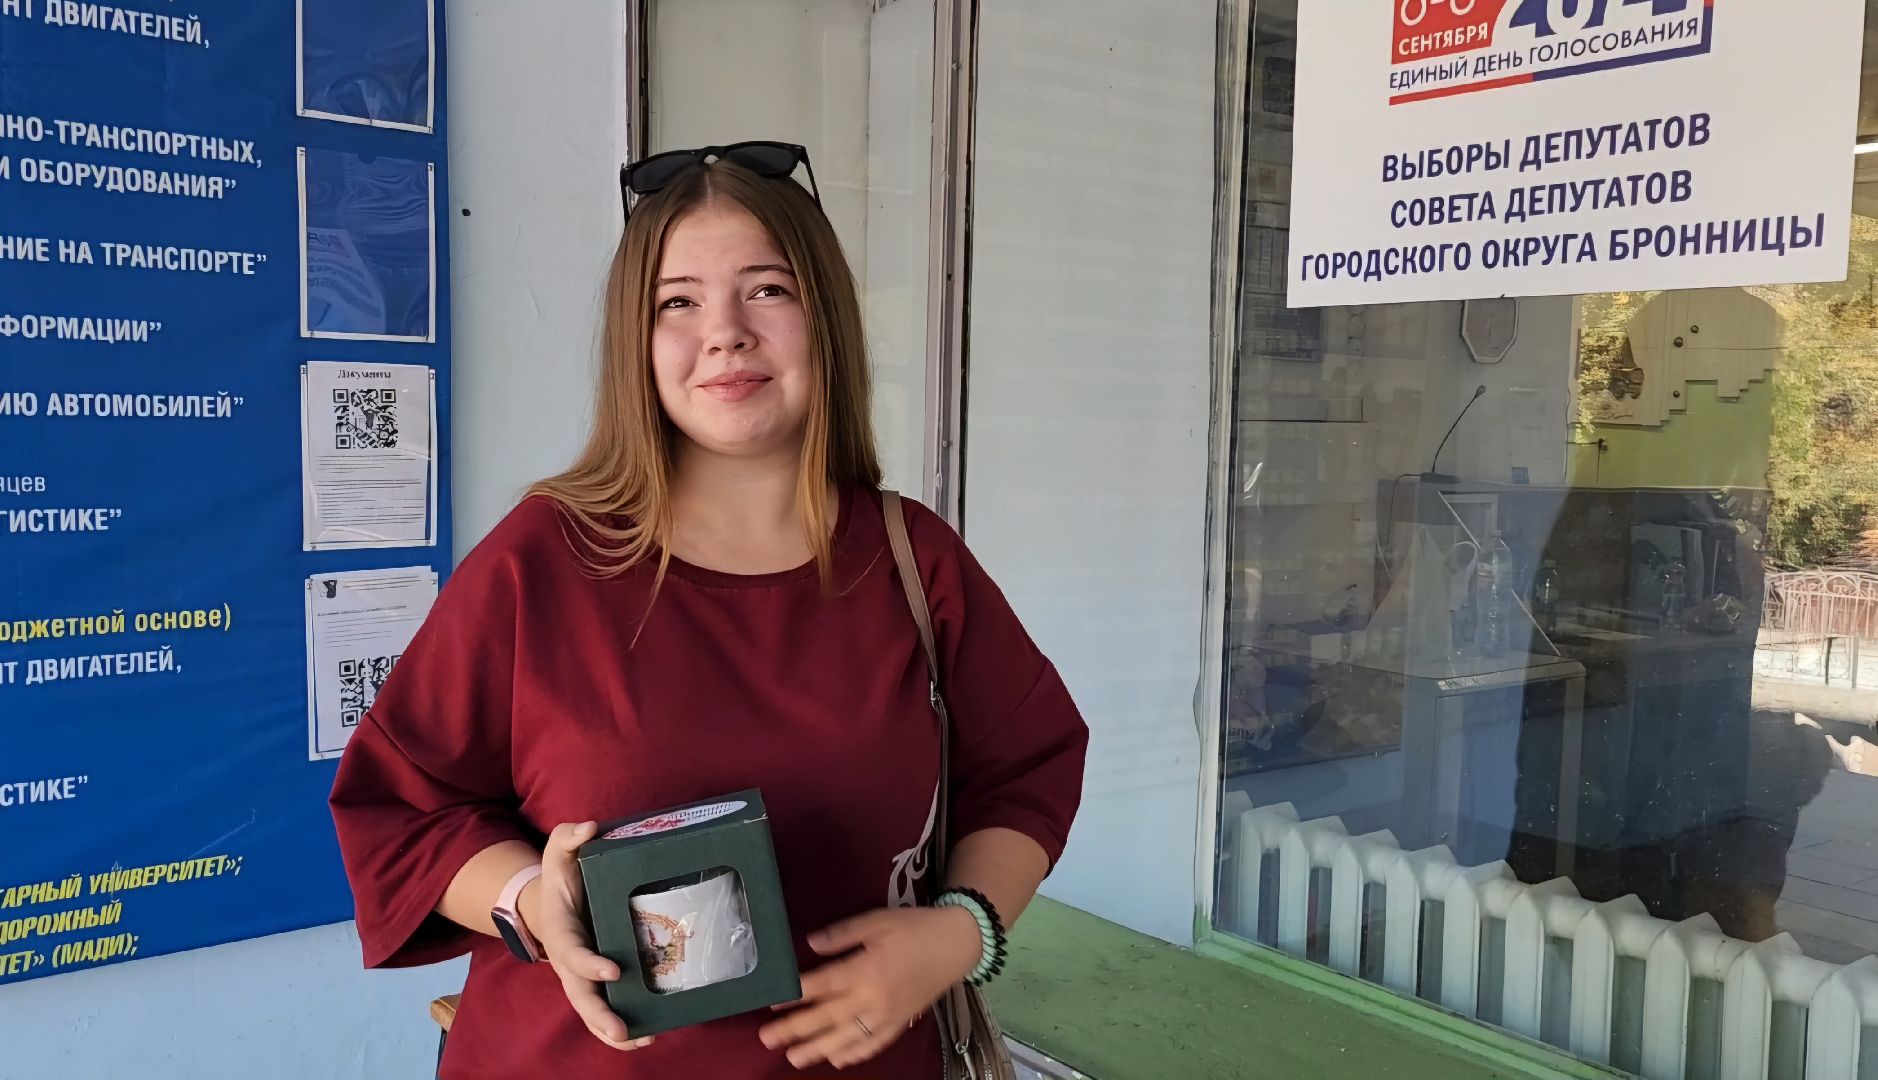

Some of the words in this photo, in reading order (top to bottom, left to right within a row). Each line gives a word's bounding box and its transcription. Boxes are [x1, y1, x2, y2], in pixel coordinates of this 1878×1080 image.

[45, 0, 209, 48] ДВИГАТЕЛЕЙ,
[1398, 22, 1488, 56] СЕНТЯБРЯ
[1390, 57, 1467, 90] ЕДИНЫЙ
[1473, 51, 1522, 78] ДЕНЬ
[1529, 17, 1698, 65] ГОЛОСОВАНИЯ
[1383, 139, 1510, 182] ВЫБОРЫ
[1520, 112, 1711, 173] ДЕПУТАТОВ
[1391, 191, 1496, 228] СОВЕТА
[1504, 169, 1693, 224] ДЕПУТАТОВ
[0, 236, 49, 261] НИЕ
[59, 240, 93, 264] НА
[1302, 242, 1471, 282] ГОРОДСКОГО
[1482, 232, 1597, 269] ОКРУГА
[1608, 213, 1825, 261] БРОННИЦЫ
[0, 393, 37, 416] ИЮ
[135, 603, 230, 631] основе)
[26, 645, 181, 685] ДВИГАТЕЛЕЙ,
[0, 873, 83, 908] АРНЫЙ
[90, 855, 242, 894] УНИВЕРСИТЕТ»;
[52, 932, 139, 968] (МАДИ);
